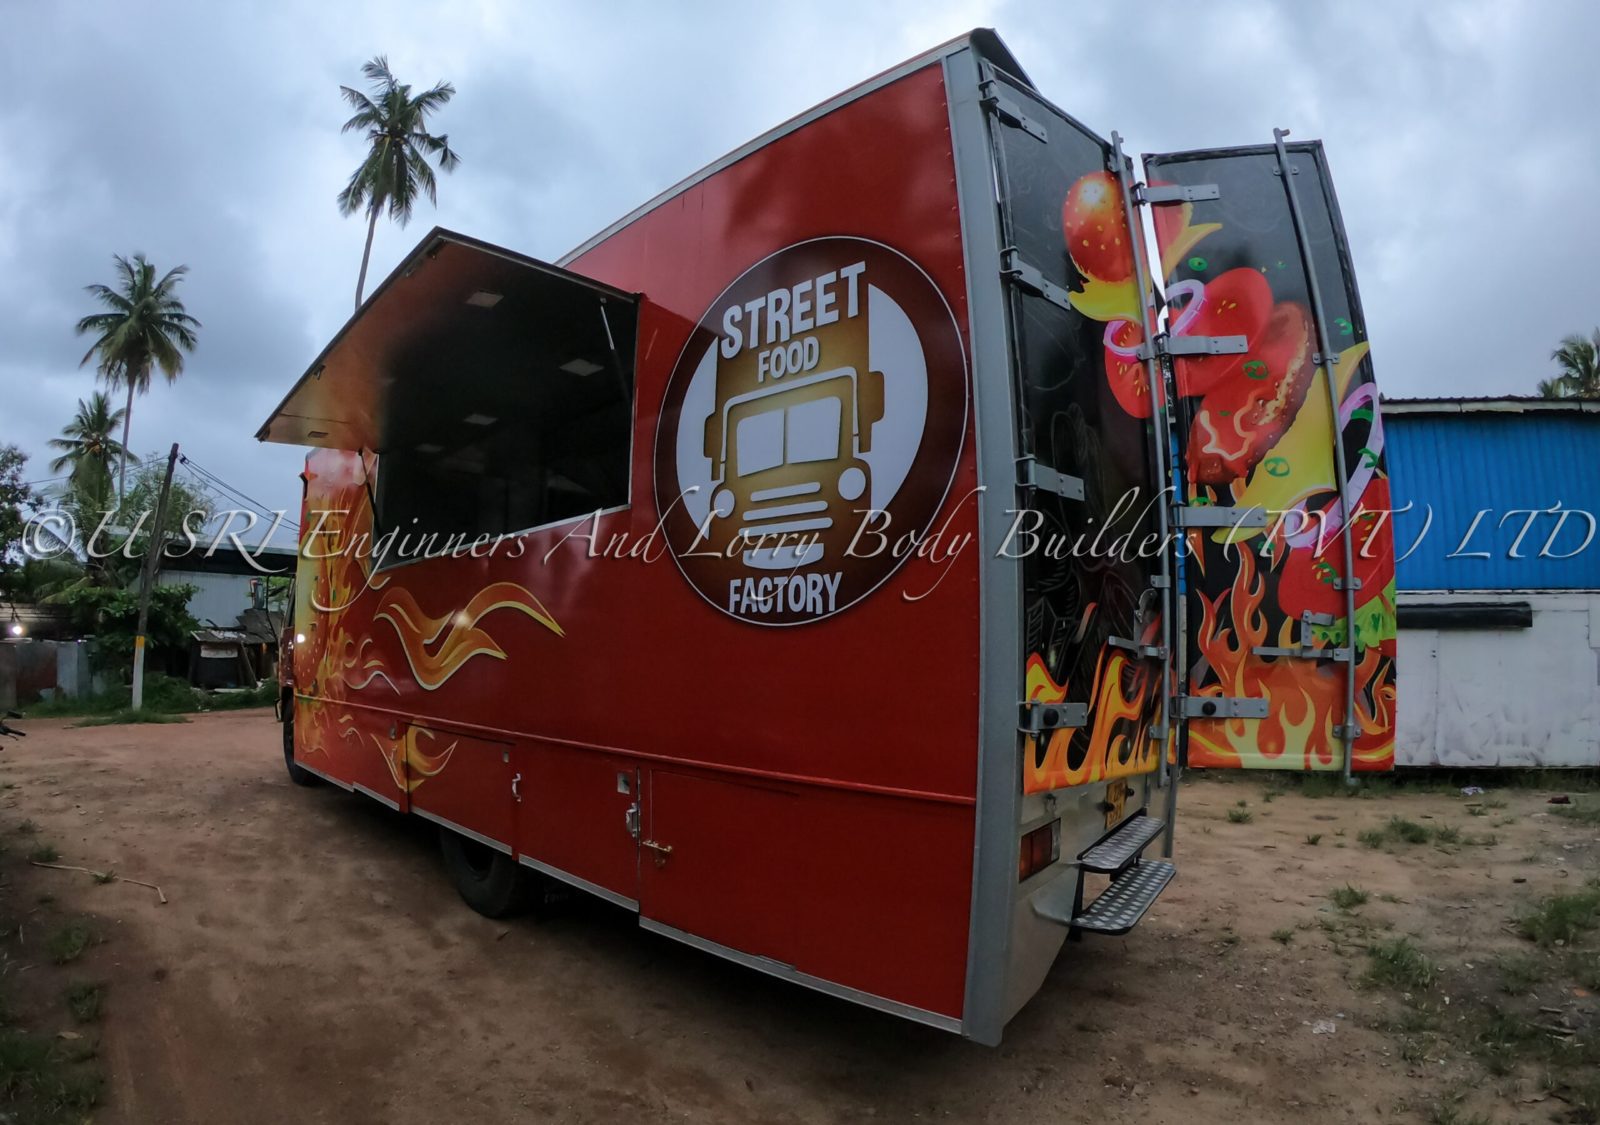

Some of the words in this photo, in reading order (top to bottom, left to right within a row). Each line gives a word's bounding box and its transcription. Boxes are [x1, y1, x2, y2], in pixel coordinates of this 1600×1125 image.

[721, 261, 866, 360] STREET
[758, 336, 820, 383] FOOD
[728, 571, 844, 616] FACTORY
